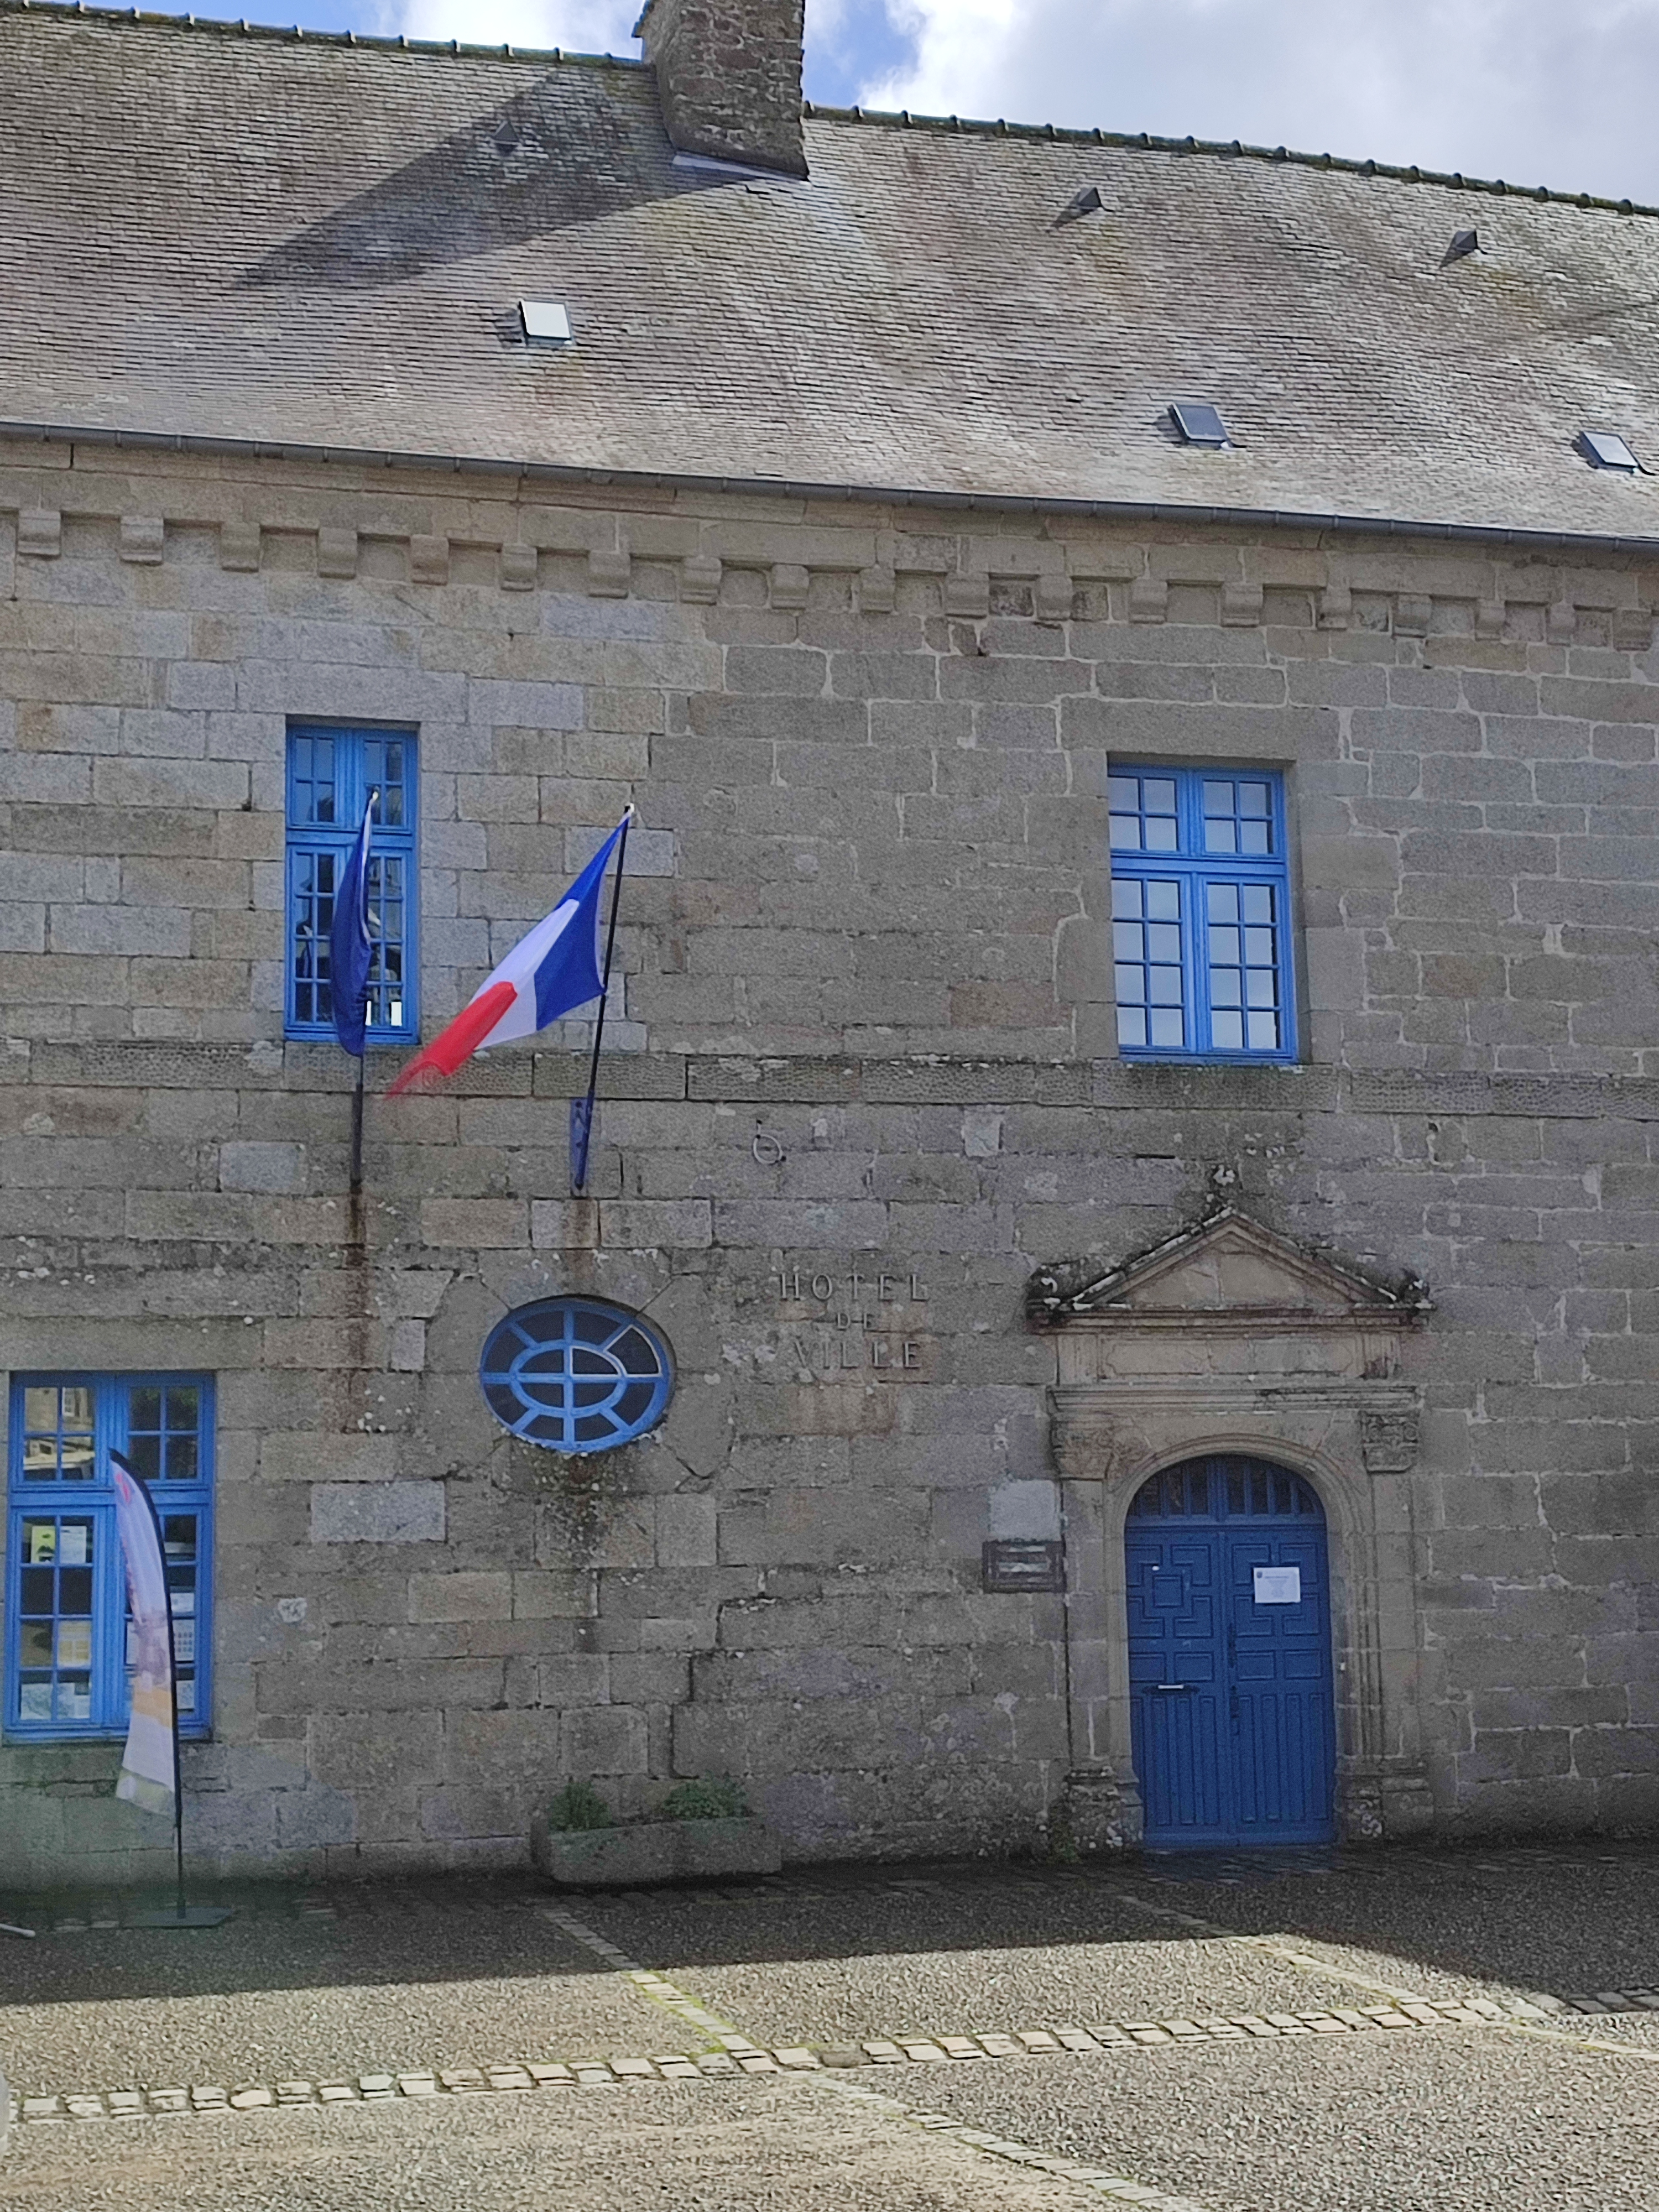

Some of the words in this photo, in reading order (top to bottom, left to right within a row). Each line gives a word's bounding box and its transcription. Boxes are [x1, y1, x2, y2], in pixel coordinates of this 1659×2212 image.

[780, 1272, 929, 1301] HOTEL
[836, 1313, 875, 1332] DE
[794, 1340, 921, 1370] VILLE
